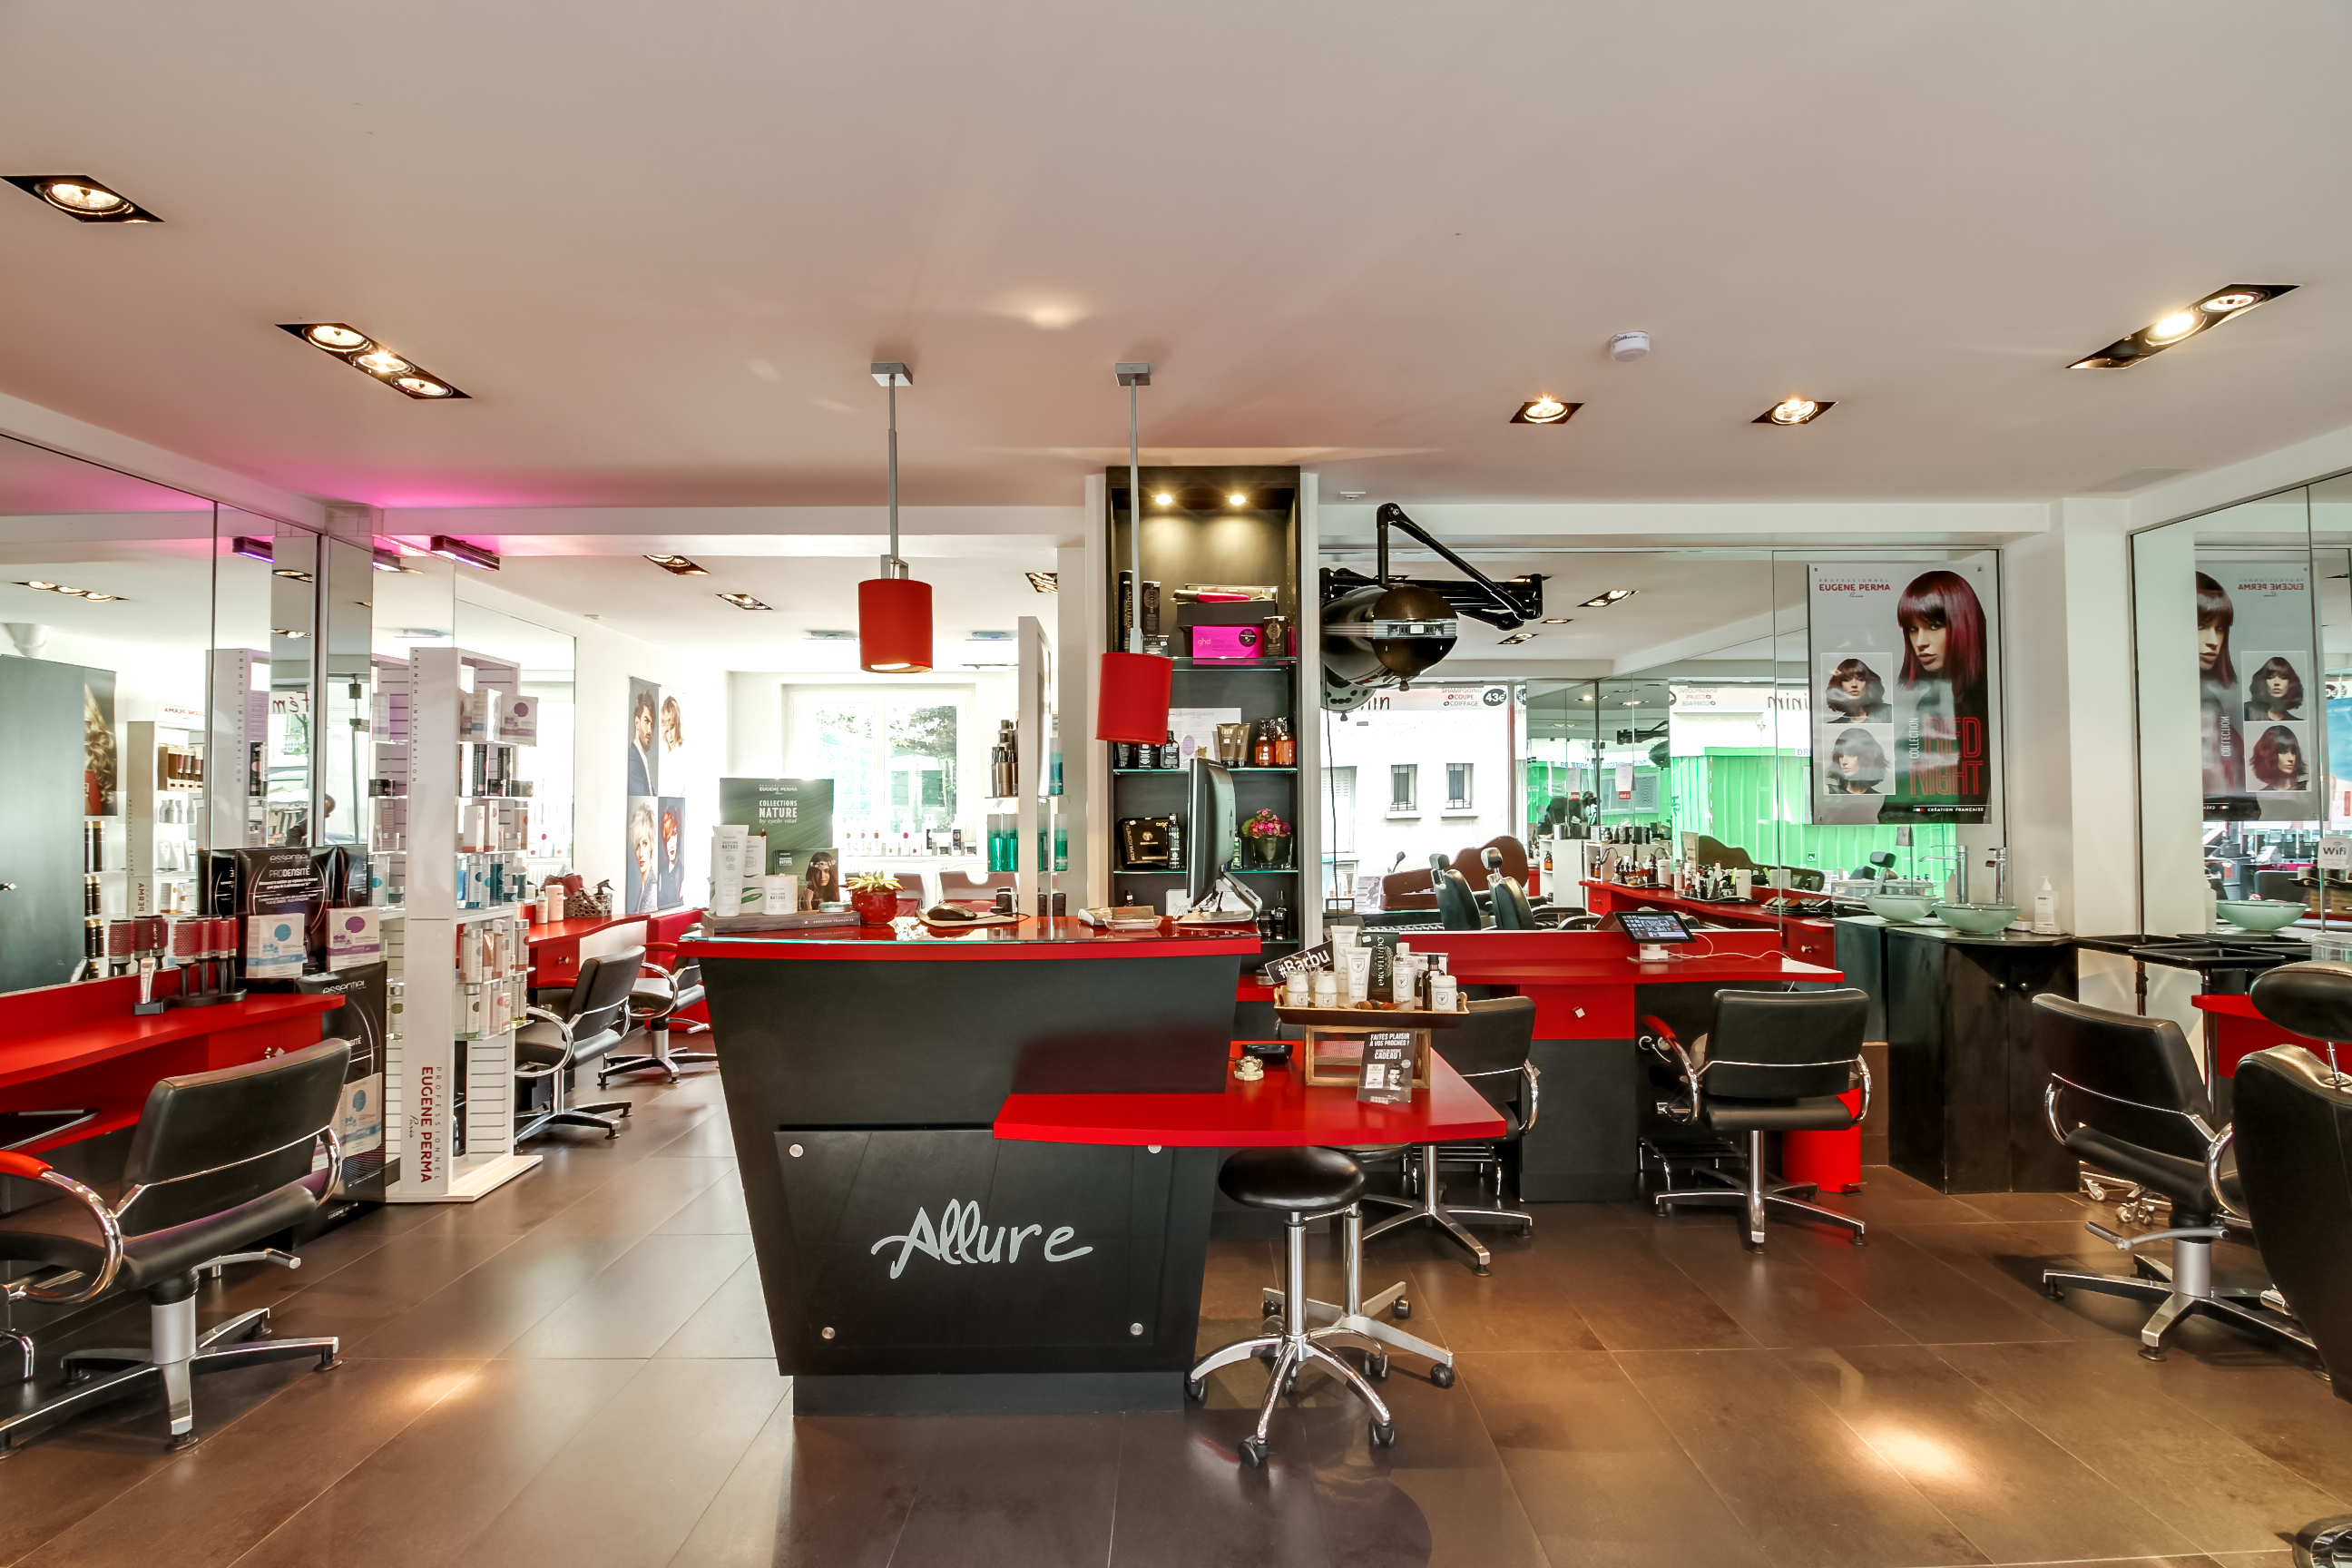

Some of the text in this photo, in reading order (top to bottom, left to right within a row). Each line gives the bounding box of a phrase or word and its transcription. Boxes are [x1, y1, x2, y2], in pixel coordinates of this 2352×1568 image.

[1818, 583, 1891, 592] EUGENE PERMA
[1197, 638, 1211, 647] ghd
[1485, 691, 1506, 702] 43€
[1908, 717, 1919, 760] COLLECTION
[1924, 716, 1982, 759] RED
[1909, 760, 1984, 795] NIGHT
[759, 807, 798, 818] NATURE
[759, 818, 767, 826] by
[767, 818, 783, 826] cycle
[2322, 847, 2347, 856] Wifi
[1278, 949, 1331, 980] #Barbu
[1374, 1052, 1398, 1060] CADEAU
[420, 1066, 434, 1183] EUGENE PERMA
[434, 1066, 443, 1181] PROFESSIONNEL
[870, 1198, 1093, 1279] Allure
